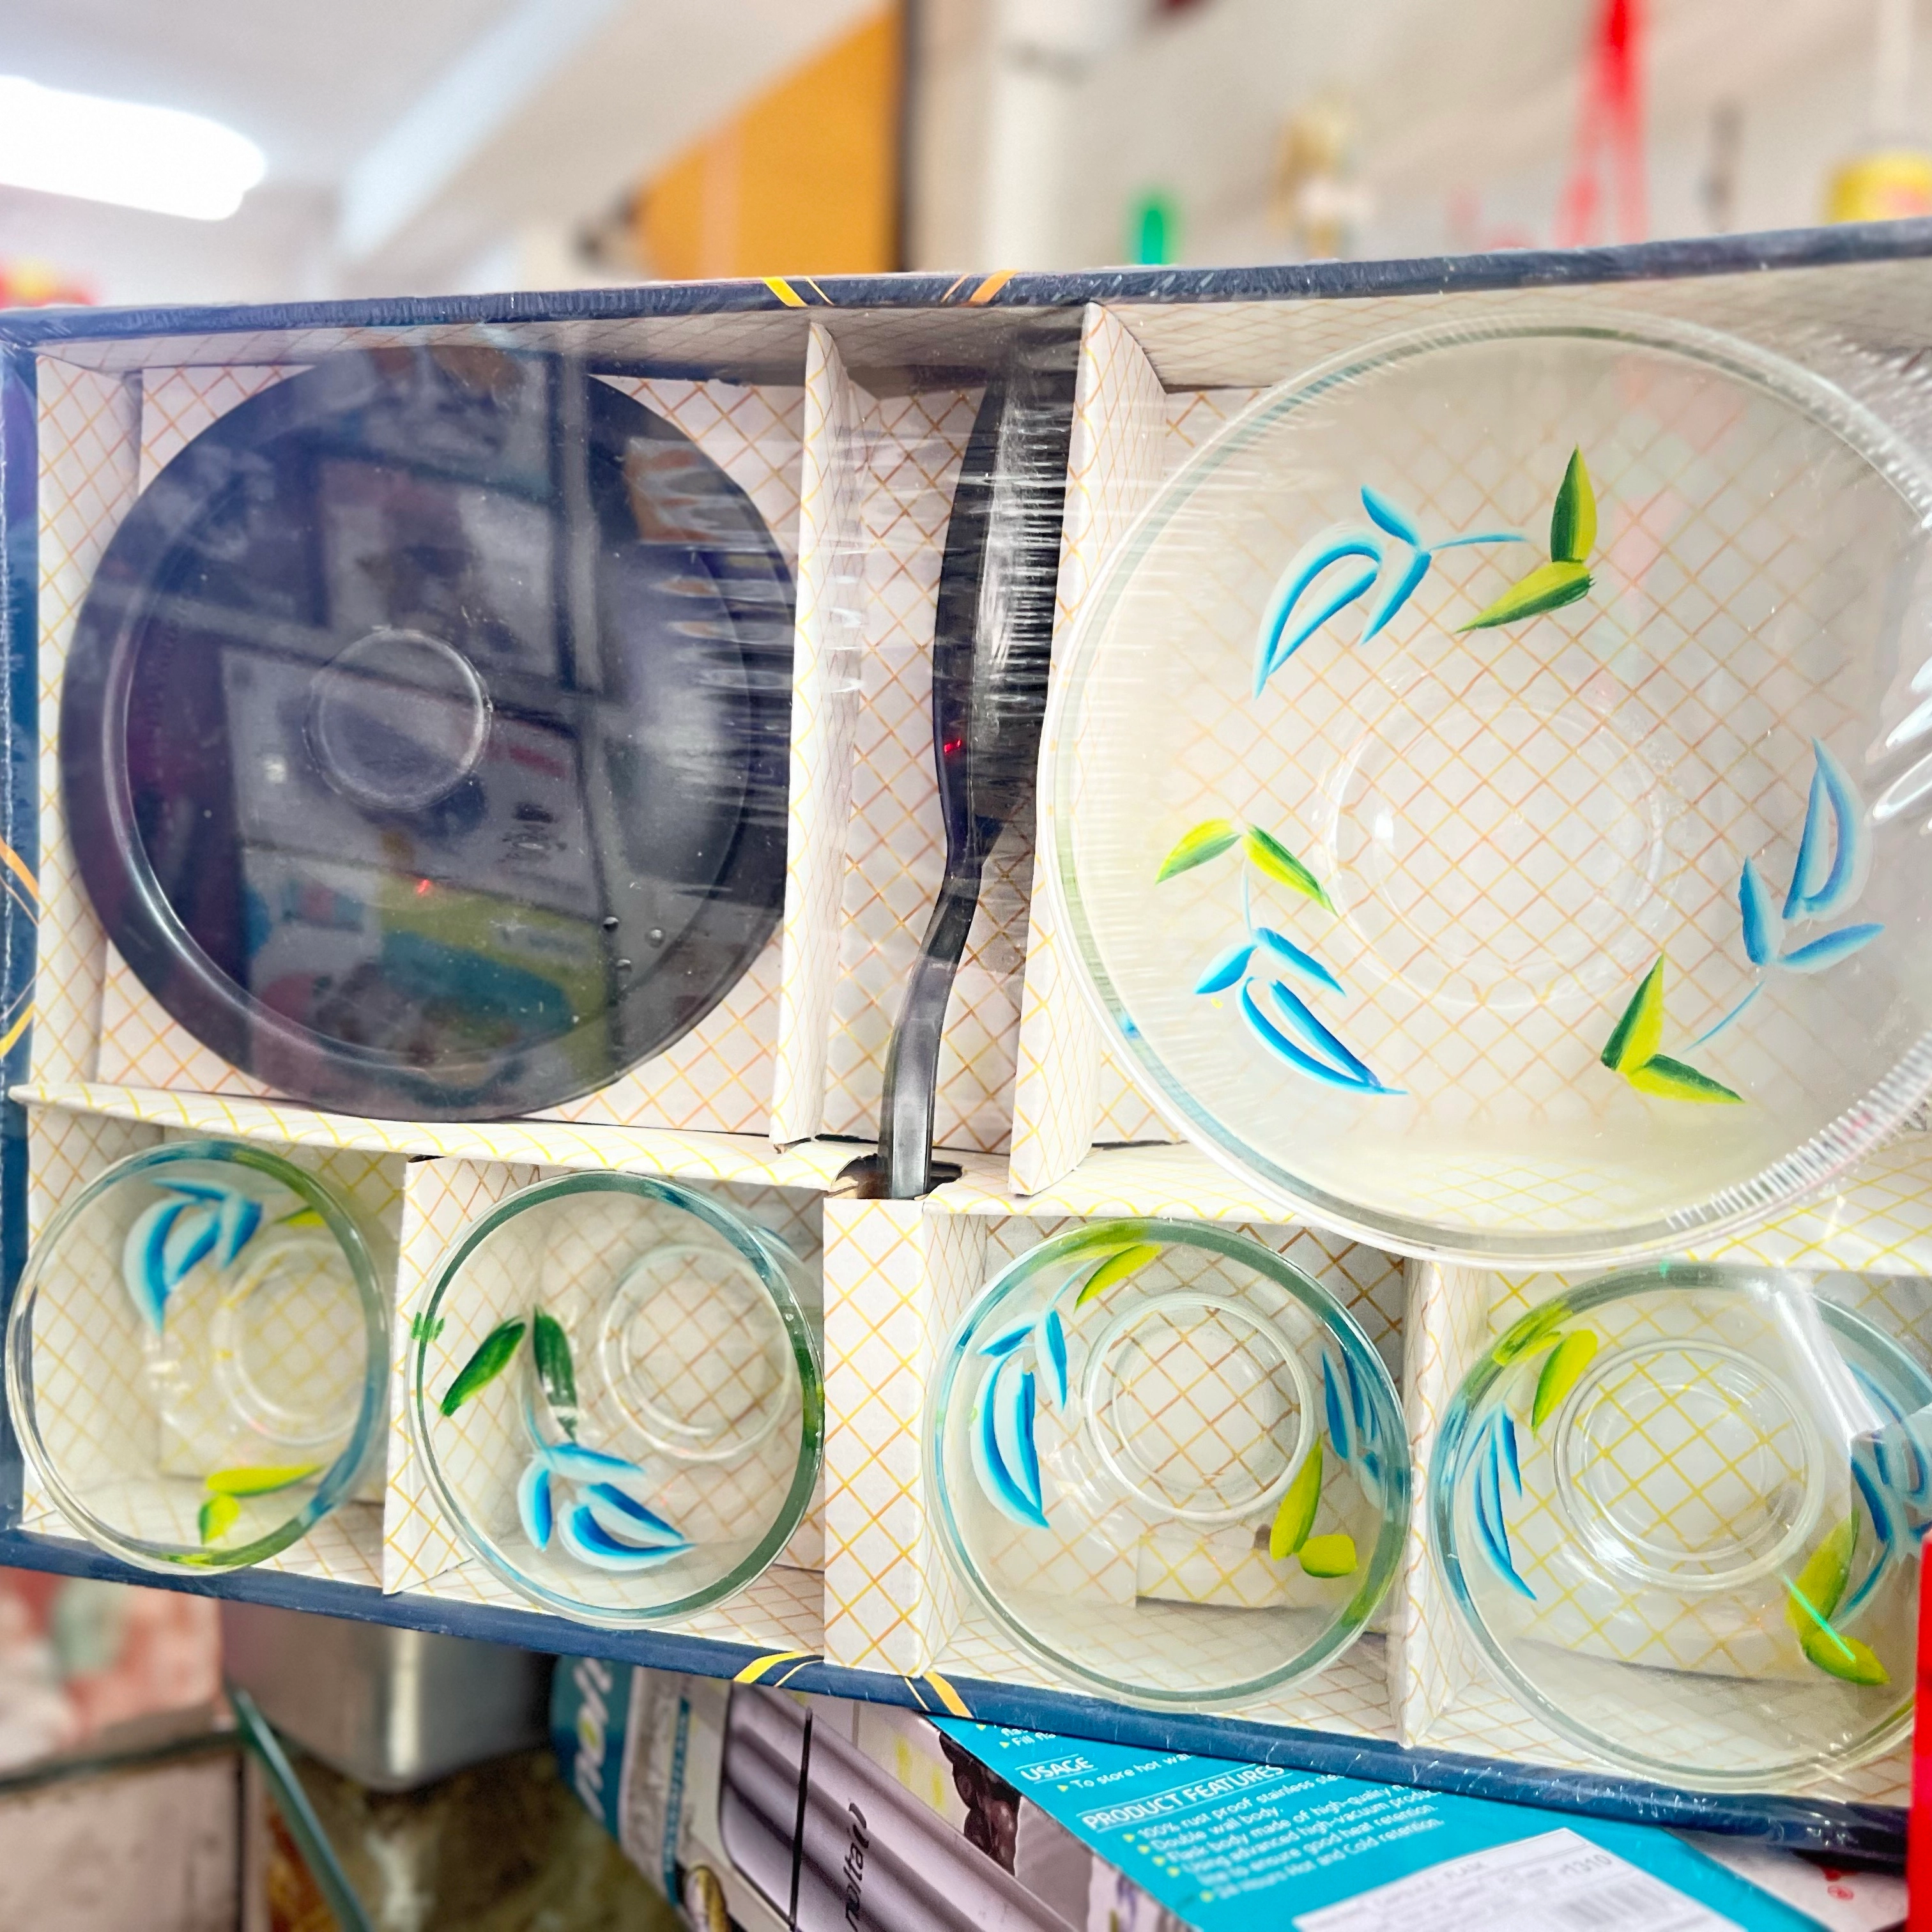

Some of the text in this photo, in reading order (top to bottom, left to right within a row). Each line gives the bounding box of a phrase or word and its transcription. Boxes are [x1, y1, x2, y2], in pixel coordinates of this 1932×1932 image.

[1020, 1756, 1094, 1781] USAGE
[1069, 1752, 1193, 1789] To store hot wa
[1082, 1764, 1285, 1830] PRODUCT FEATURES
[1180, 1812, 1212, 1828] rust
[1211, 1796, 1254, 1820] proof
[1255, 1779, 1315, 1804] stainless
[1150, 1806, 1284, 1851] Double wall body.
[1206, 1832, 1250, 1853] body
[1249, 1818, 1292, 1838] made
[1292, 1809, 1311, 1823] of
[1310, 1786, 1393, 1816] high-quality
[1302, 1832, 1343, 1855] good
[1338, 1821, 1375, 1839] heat
[1343, 1836, 1380, 1854] Cold
